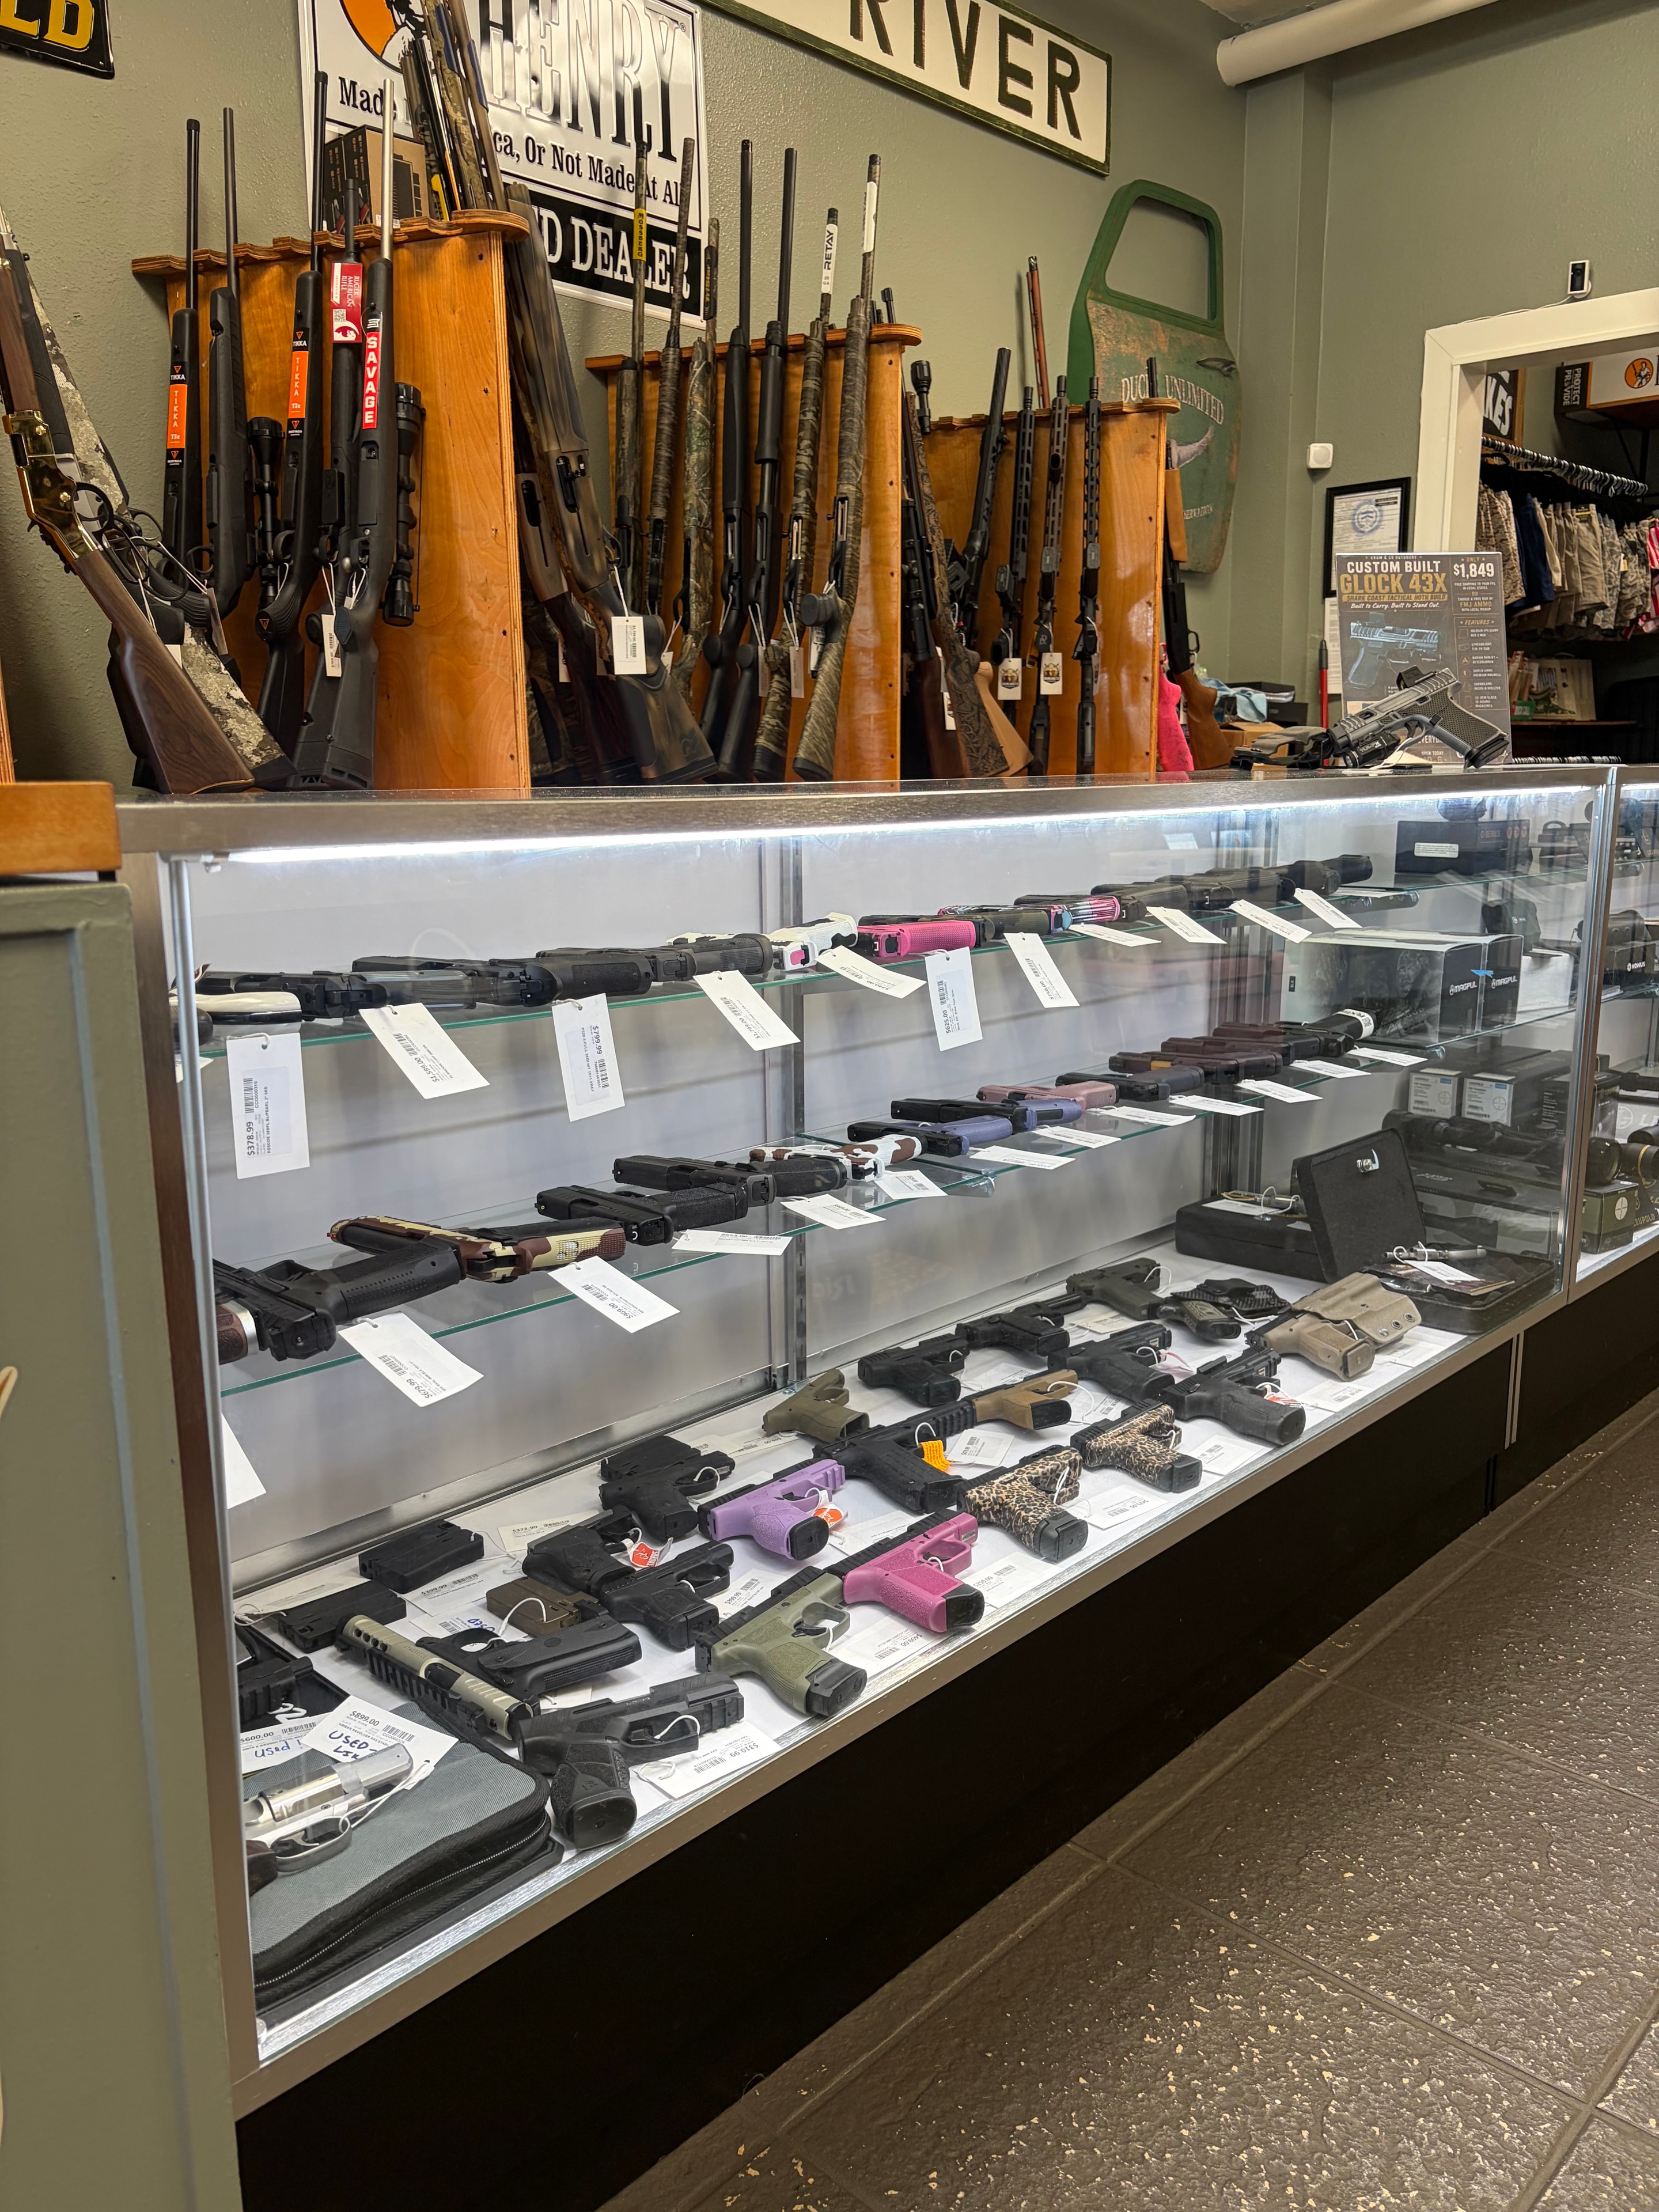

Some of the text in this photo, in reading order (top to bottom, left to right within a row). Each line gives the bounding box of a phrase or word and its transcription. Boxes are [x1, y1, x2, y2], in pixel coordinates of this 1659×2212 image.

[479, 0, 681, 163] HENRY
[339, 76, 397, 118] Mad
[525, 136, 546, 166] Or
[551, 143, 582, 177] Not
[588, 155, 634, 193] Made
[636, 212, 645, 257] MOSSBERG
[570, 216, 691, 300] DEAER
[824, 229, 835, 270] RETAY
[365, 336, 378, 423] SAVAGE
[1120, 374, 1225, 425] DUC UNLIMITED
[1347, 560, 1441, 573] CUSTOM BUILT
[1453, 563, 1494, 579] $1,849
[1340, 573, 1448, 594] GLOCK 43X
[1455, 981, 1478, 994] MAGPUL
[1497, 976, 1518, 987] MAGPUL
[738, 1016, 761, 1040] $1,799.00
[942, 1010, 951, 1033] $625.00
[592, 1025, 602, 1055] $799.99
[414, 1056, 440, 1082] $1,599.00
[245, 1121, 255, 1156] $378.99
[608, 1302, 633, 1319] $969.00
[407, 1378, 433, 1399] $679.99
[349, 1710, 380, 1726] $899.00
[240, 1731, 274, 1743] $600.00
[730, 1743, 759, 1757] $310.99
